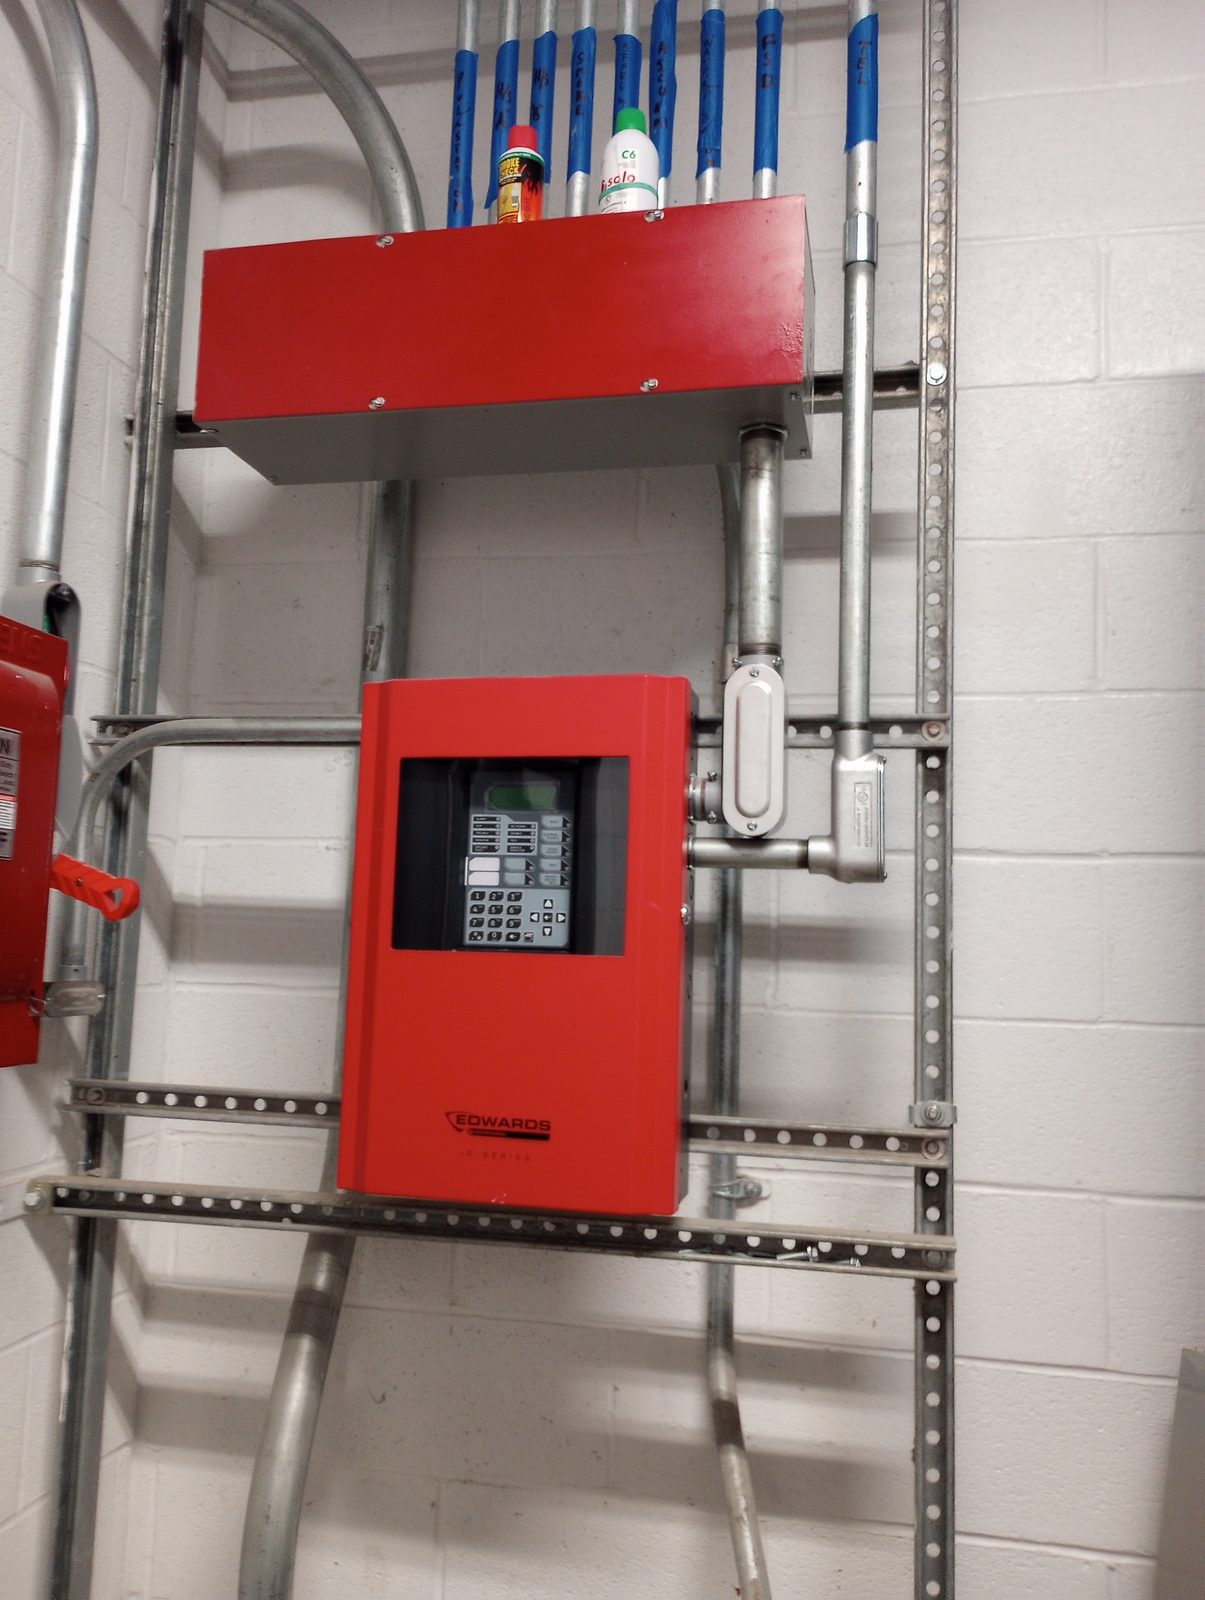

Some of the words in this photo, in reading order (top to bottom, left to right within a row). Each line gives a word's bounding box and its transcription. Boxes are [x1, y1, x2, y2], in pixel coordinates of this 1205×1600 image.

[856, 41, 872, 85] TEL
[622, 150, 636, 160] C6
[608, 170, 636, 188] solo
[456, 1114, 551, 1131] EDWARDS
